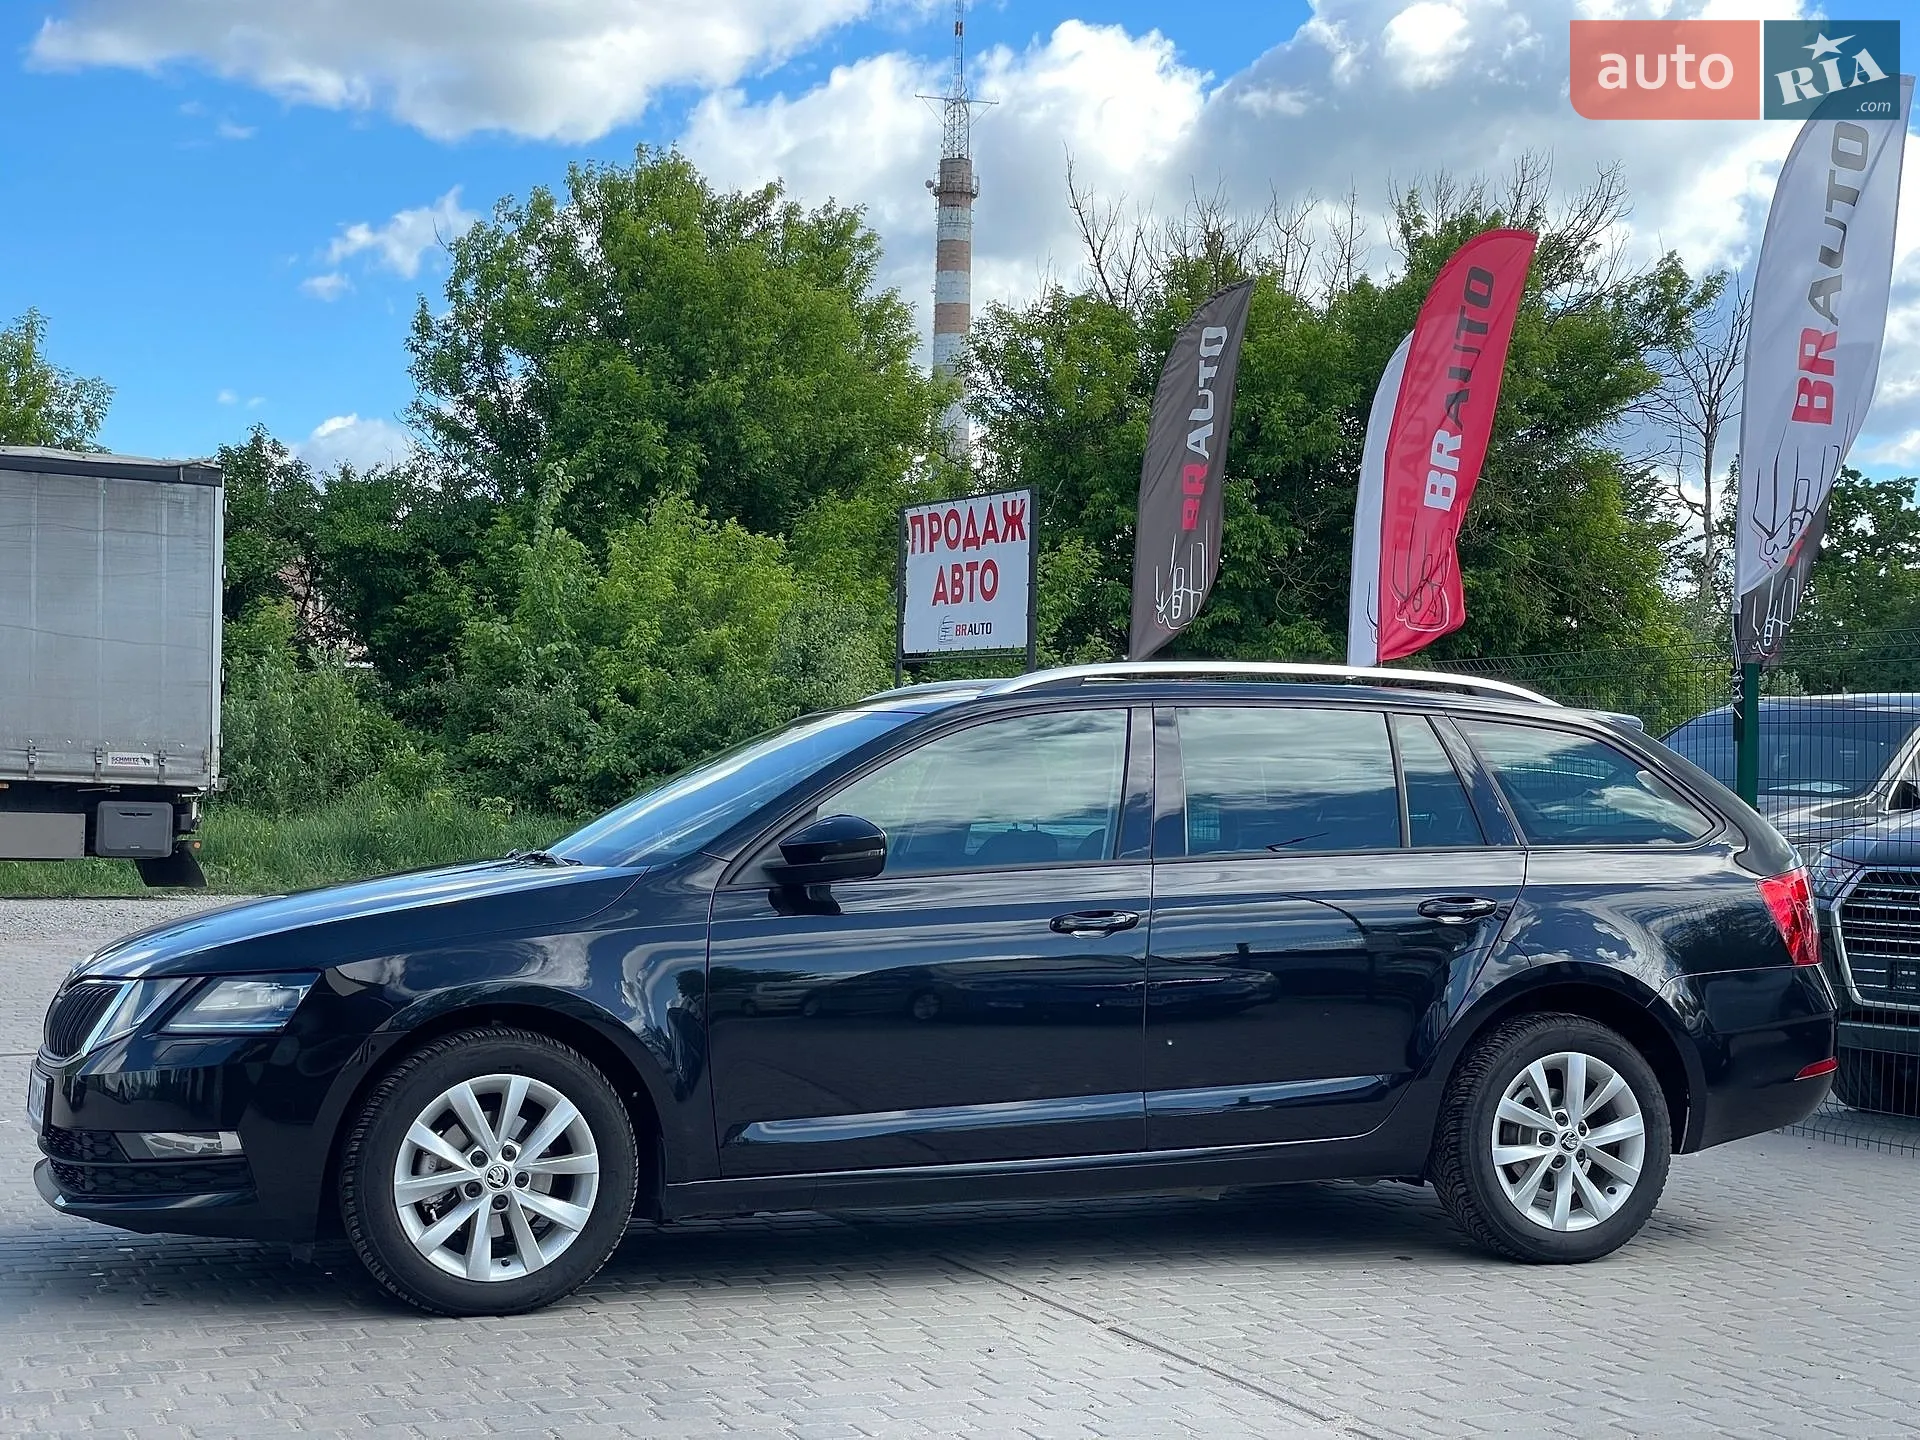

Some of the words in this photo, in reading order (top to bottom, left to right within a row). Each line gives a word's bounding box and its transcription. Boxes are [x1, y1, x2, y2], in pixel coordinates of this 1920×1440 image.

[1792, 121, 1871, 425] BRAUTO
[1181, 325, 1228, 532] BRAUTO
[1423, 265, 1495, 512] BRAUTO
[910, 499, 1026, 554] ПРОДАЖ
[932, 559, 999, 606] АВТО
[955, 622, 992, 636] BRAUTO
